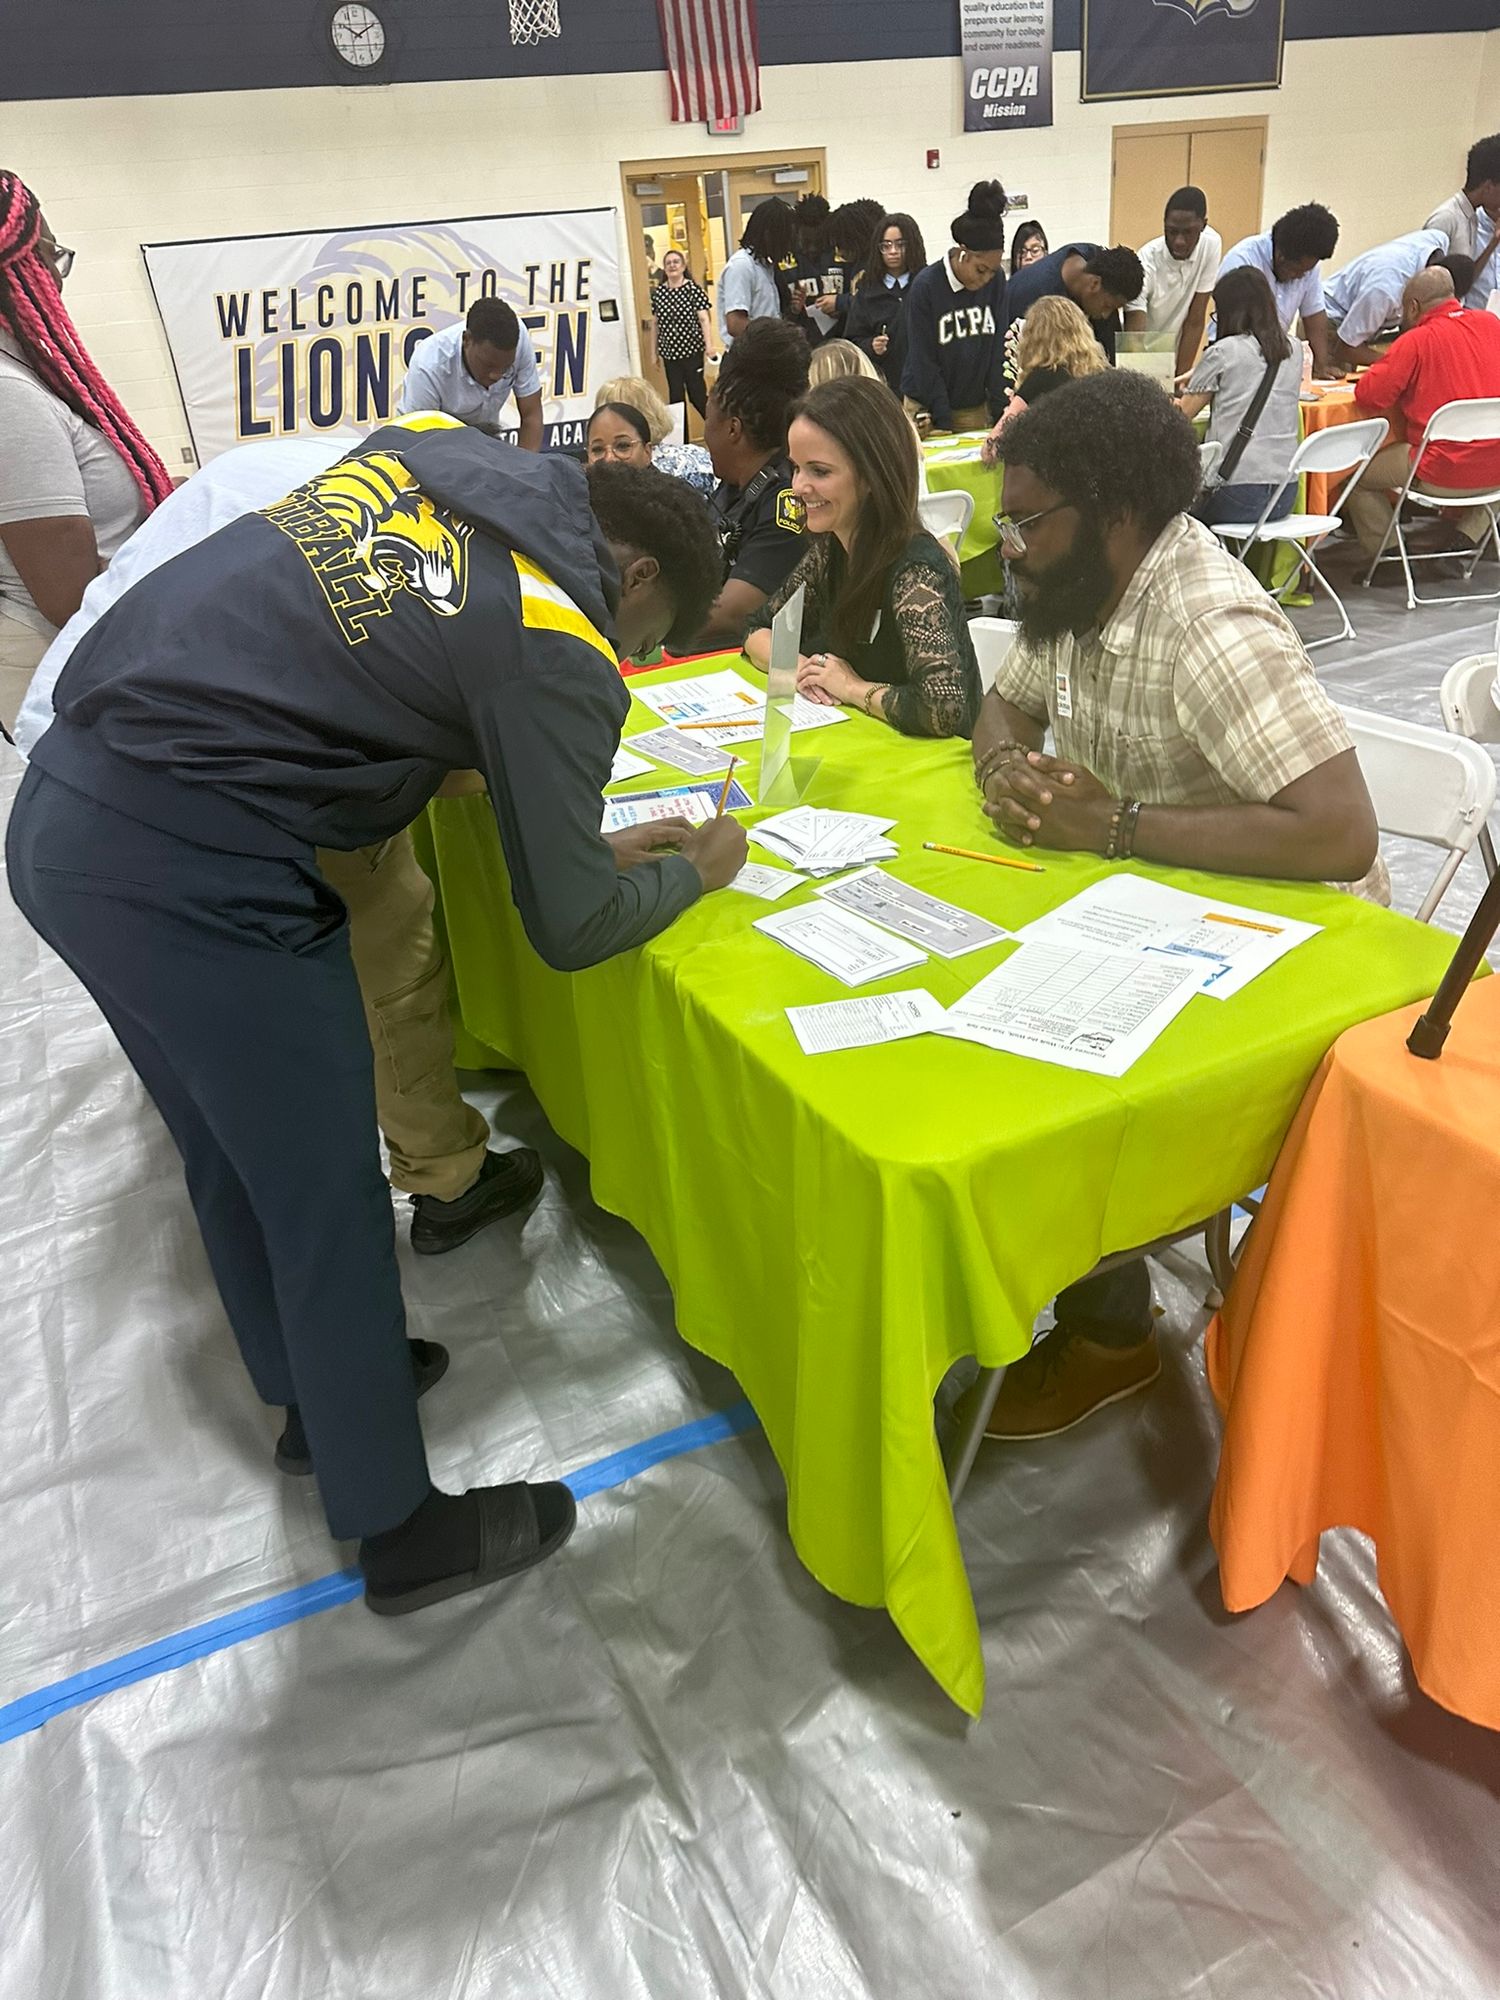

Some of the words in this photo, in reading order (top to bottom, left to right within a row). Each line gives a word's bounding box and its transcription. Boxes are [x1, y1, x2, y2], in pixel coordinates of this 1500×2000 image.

[963, 1, 990, 13] quality
[990, 1, 1029, 12] education
[1029, 0, 1045, 10] that
[964, 16, 998, 26] prepares
[999, 16, 1013, 24] our
[1013, 14, 1044, 25] learning
[963, 28, 1005, 39] community
[1005, 28, 1018, 37] for
[1018, 27, 1046, 38] college
[964, 42, 978, 52] and
[979, 42, 1004, 51] career
[1004, 40, 1043, 50] readiness.
[969, 65, 1039, 100] CCPA
[982, 102, 1027, 119] Mission
[214, 274, 428, 340] WELCOME
[455, 268, 498, 313] TO
[525, 260, 592, 306] THE
[937, 302, 997, 345] CCPA
